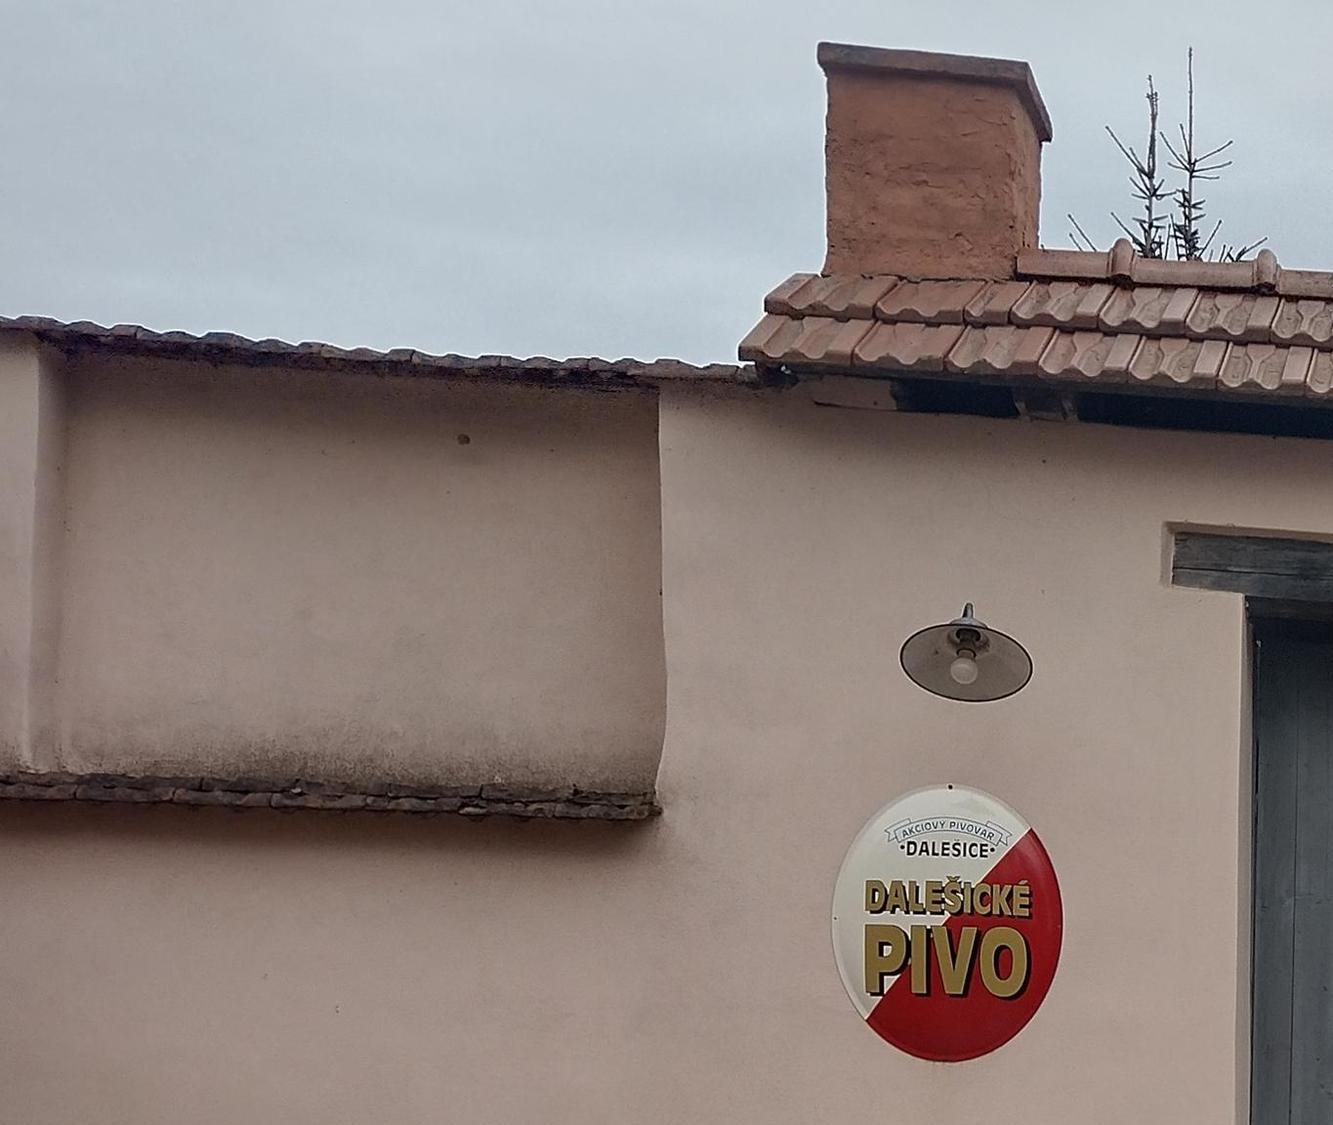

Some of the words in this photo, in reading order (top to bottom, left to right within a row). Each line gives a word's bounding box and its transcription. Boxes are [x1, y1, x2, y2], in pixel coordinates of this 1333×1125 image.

[949, 821, 995, 840] PIVOVAR
[864, 876, 1032, 918] DALEŠICKÉ
[864, 923, 1031, 999] PIVO
